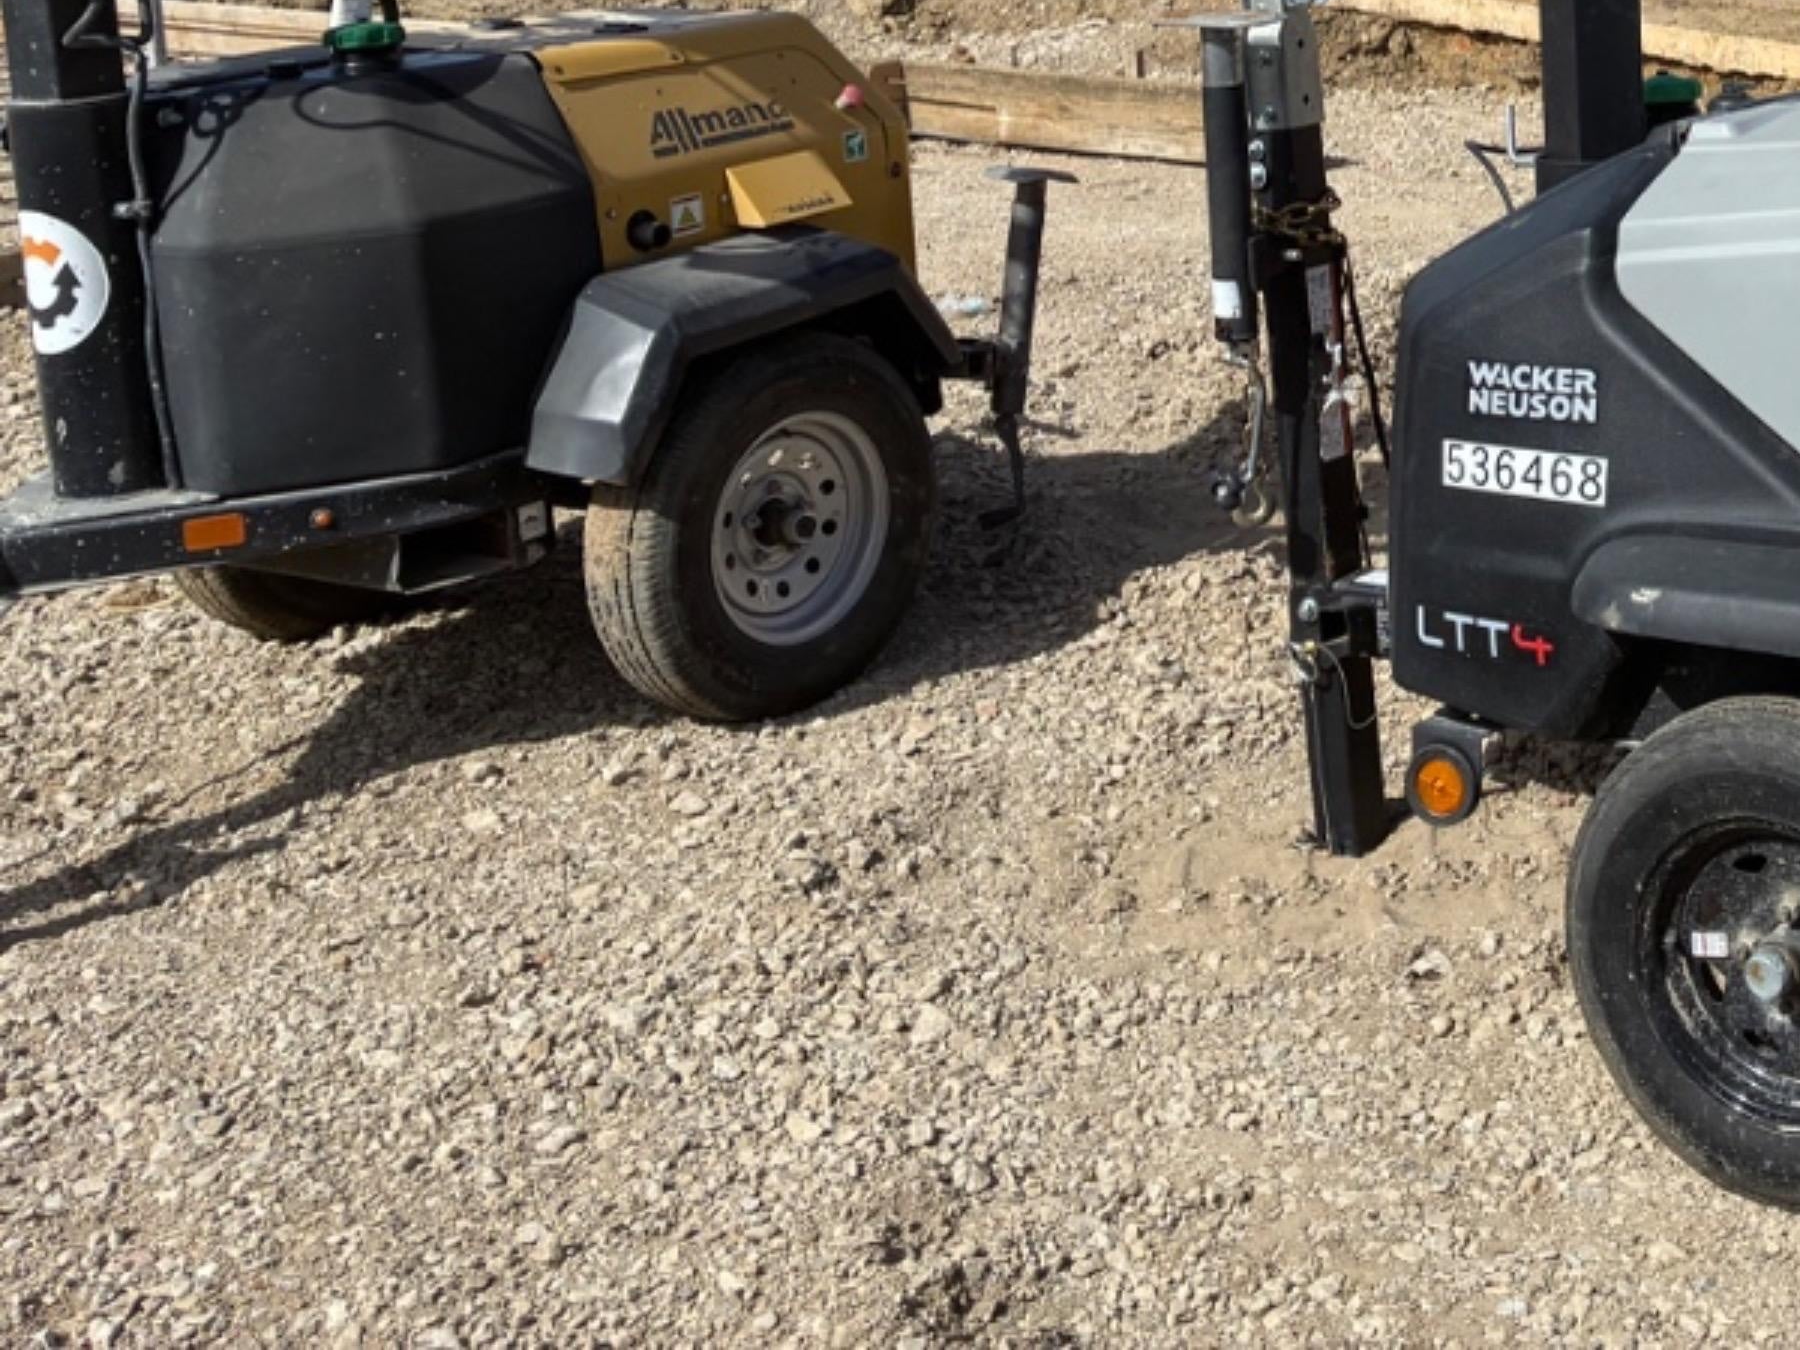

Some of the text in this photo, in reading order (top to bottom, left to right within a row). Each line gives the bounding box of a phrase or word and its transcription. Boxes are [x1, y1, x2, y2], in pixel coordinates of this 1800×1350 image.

[1467, 359, 1597, 395] WACKER
[1468, 388, 1597, 424] NEUSON
[1447, 443, 1602, 502] 536468
[1416, 603, 1556, 667] LTT4
